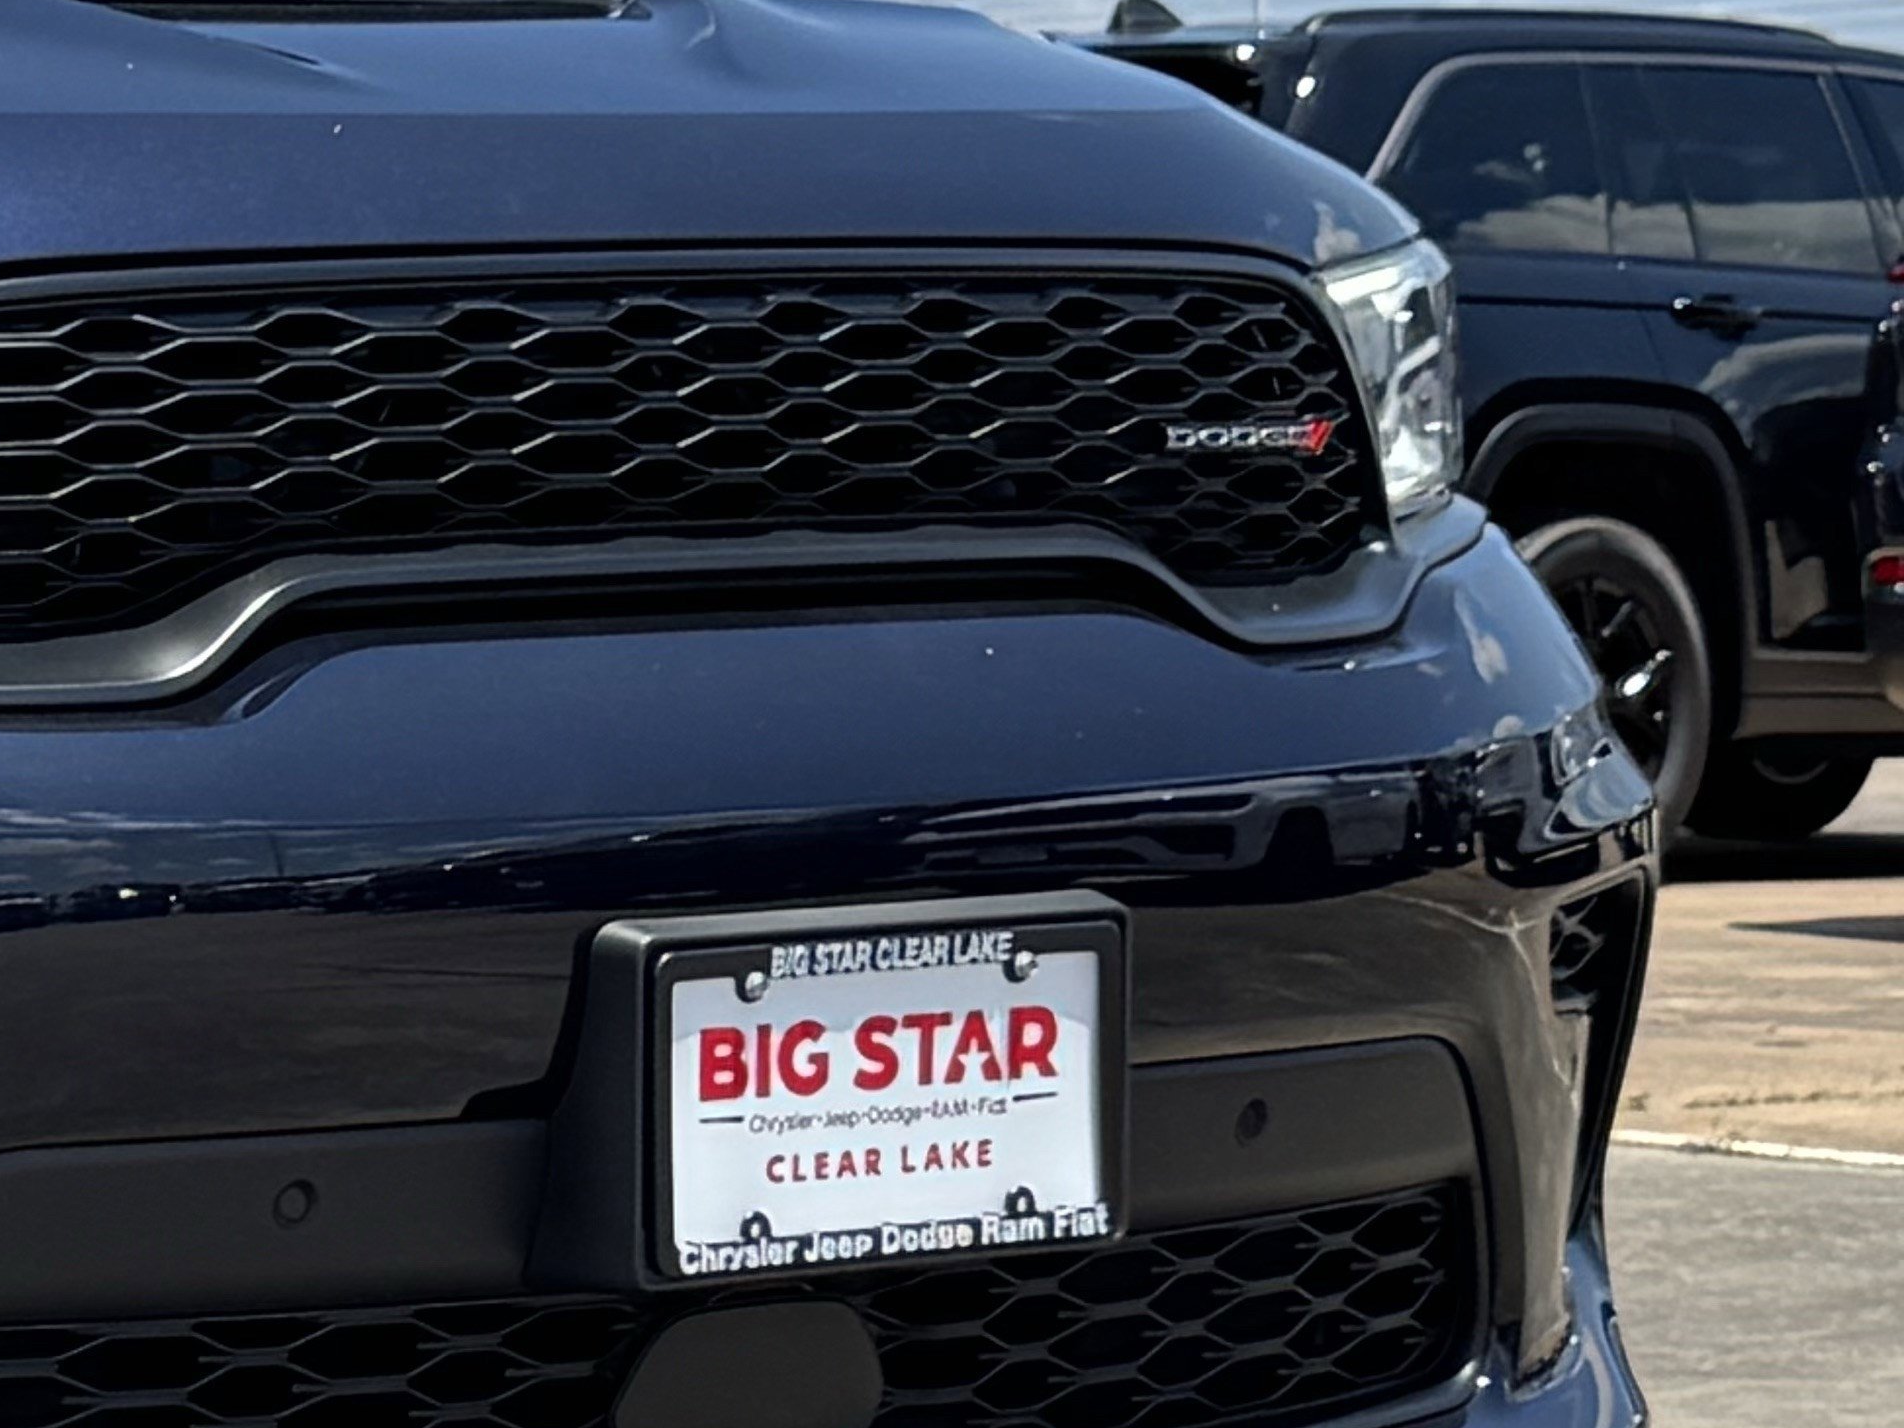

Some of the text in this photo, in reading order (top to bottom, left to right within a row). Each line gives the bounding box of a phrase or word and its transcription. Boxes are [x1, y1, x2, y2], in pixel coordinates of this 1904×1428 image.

[1165, 425, 1313, 450] DODGE
[770, 930, 1015, 978] BIG STAR CLEAR LAKE
[698, 1005, 1059, 1103] BIG STAR
[765, 1138, 994, 1184] CLEAR LAKE
[678, 1201, 1110, 1275] Chrysler Jeep Dodge Ram Fiat
